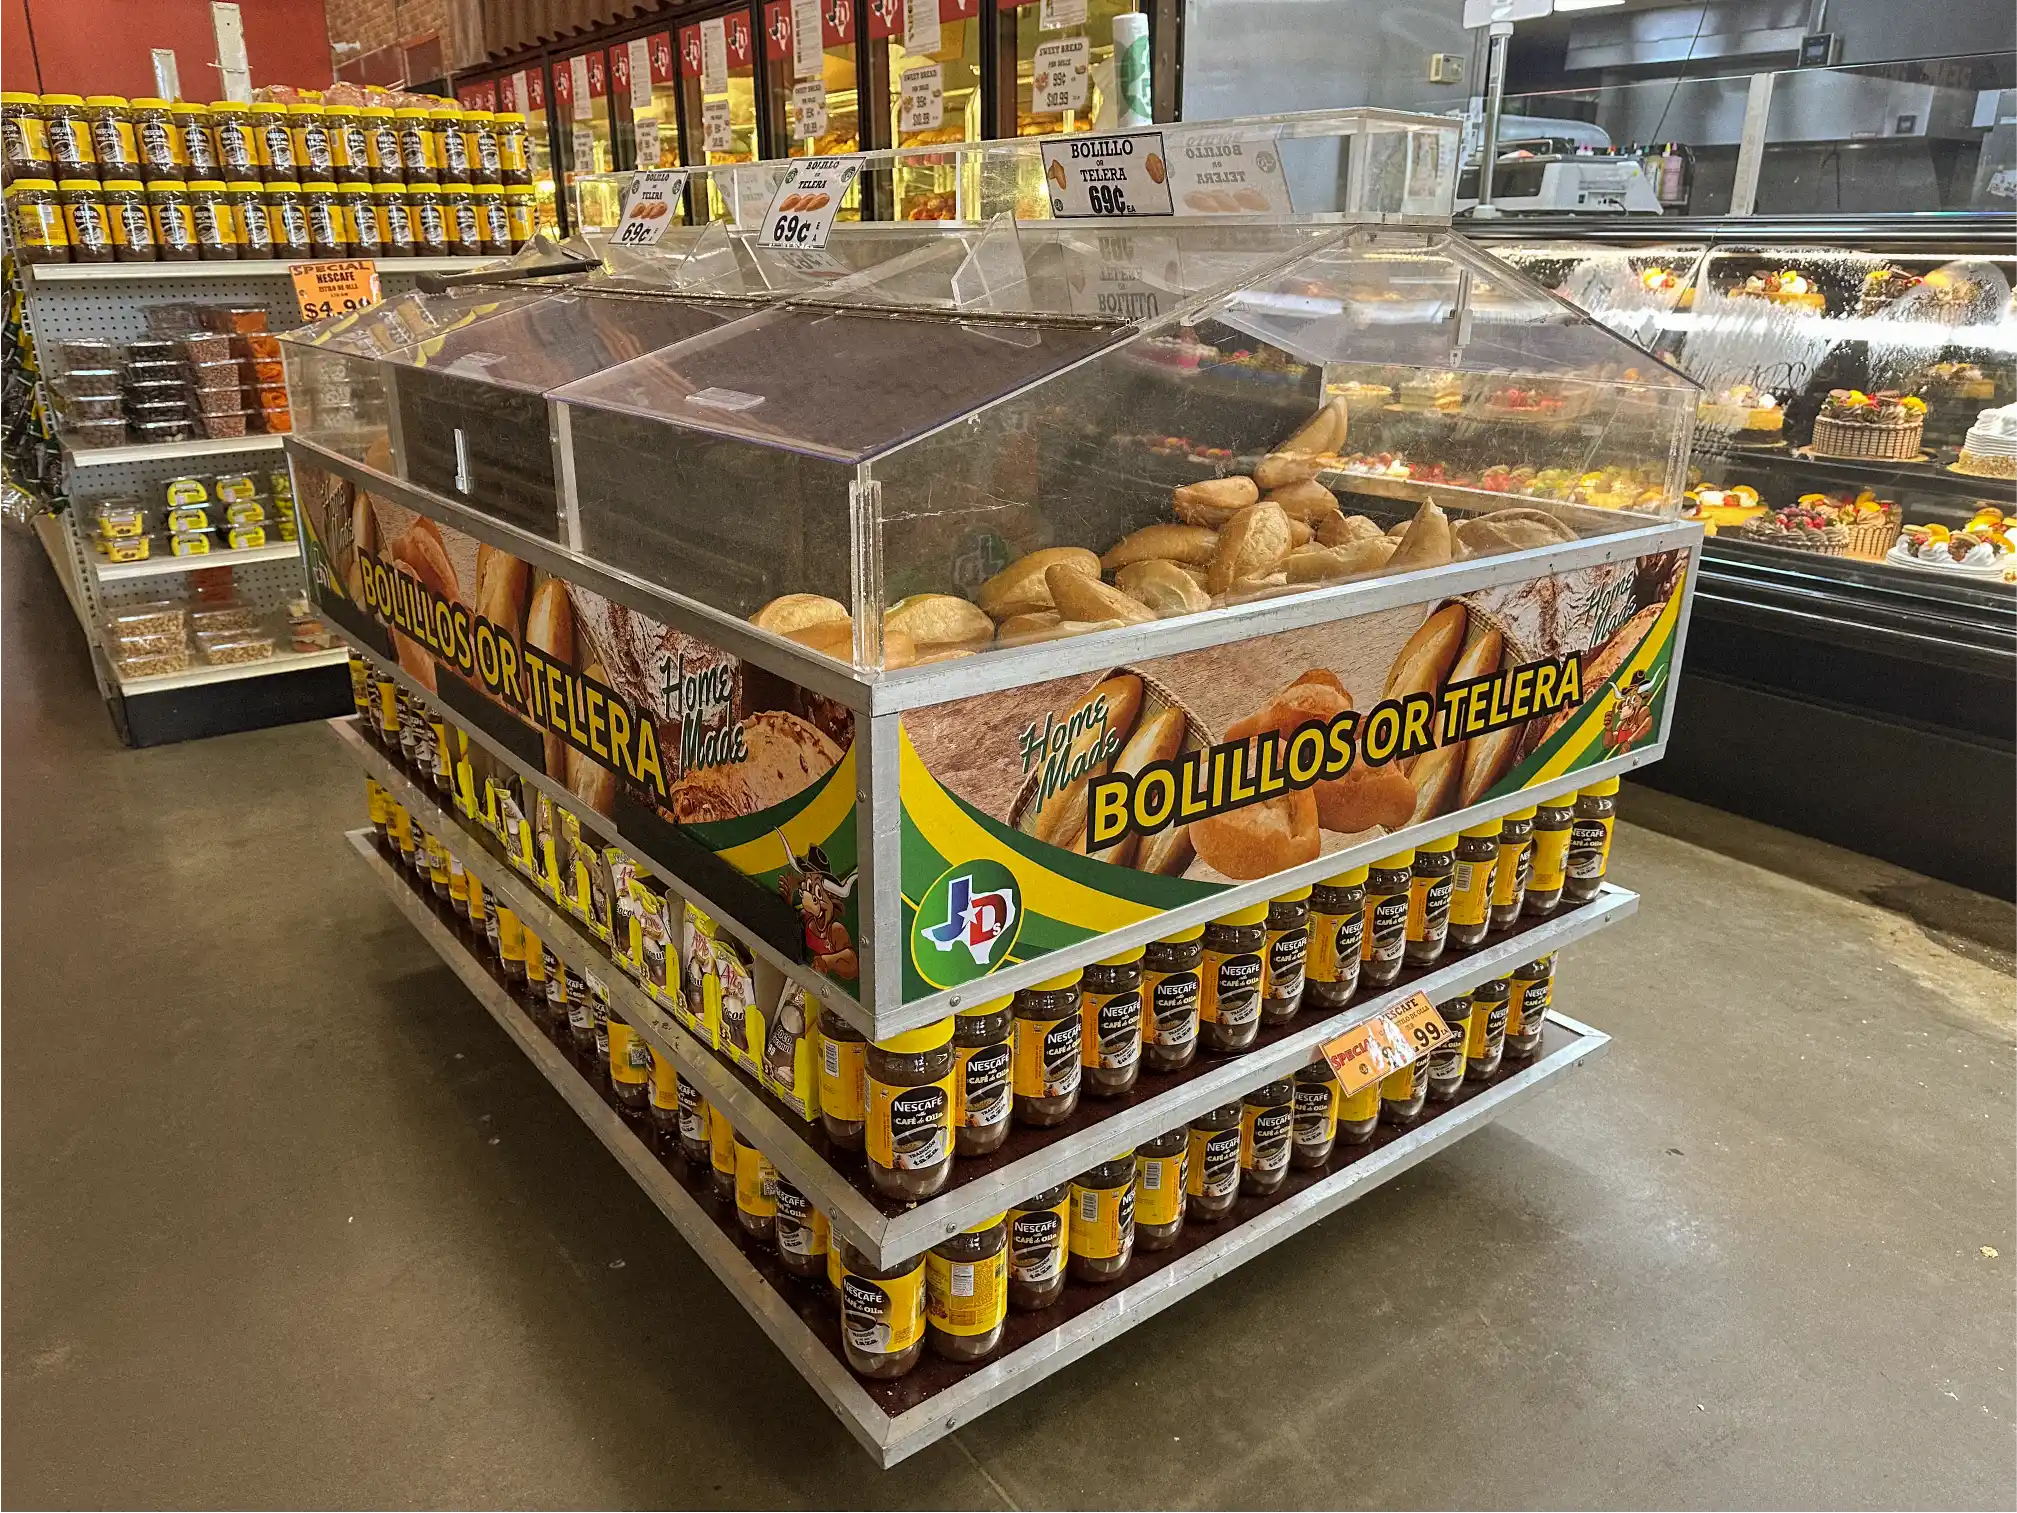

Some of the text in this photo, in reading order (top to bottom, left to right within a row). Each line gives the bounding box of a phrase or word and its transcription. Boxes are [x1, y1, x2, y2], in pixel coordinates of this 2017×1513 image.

[1039, 43, 1083, 56] SWEET BREAD
[1047, 92, 1069, 107] $10.99
[1071, 140, 1133, 158] BOLILLO
[806, 161, 840, 170] BOLILLO
[645, 174, 670, 182] BOLILLO
[1080, 168, 1127, 182] TELERA
[798, 180, 827, 189] TELERA
[642, 192, 663, 200] TELERA
[1089, 185, 1136, 215] 69¢ EA
[622, 223, 651, 243] 69¢
[774, 215, 811, 242] 69¢
[291, 262, 371, 276] SPECIAL
[316, 271, 356, 284] NESCAFE
[1583, 570, 1635, 625] Home
[360, 553, 668, 797] BOLILLOS OR TELERA
[659, 651, 734, 716] Home
[1019, 692, 1109, 773] Home
[680, 708, 749, 781] Made
[1095, 657, 1580, 844] BOLILLOS OR TELERA
[1036, 717, 1120, 812] Made
[1430, 884, 1453, 897] NESCA
[1341, 920, 1364, 934] NESC
[1222, 978, 1239, 987] CAFÉ
[1158, 998, 1176, 1007] CAFÉ
[1411, 1012, 1418, 1020] DE
[1418, 1005, 1430, 1015] OLLA
[1330, 1038, 1369, 1071] SPECIA
[969, 1075, 988, 1084] CAFÉ
[894, 1091, 943, 1112] NESCAFÉ
[895, 1117, 917, 1125] CAFÉ
[1014, 1216, 1057, 1233] NESCAFÉ
[1016, 1236, 1033, 1244] CAFÉ
